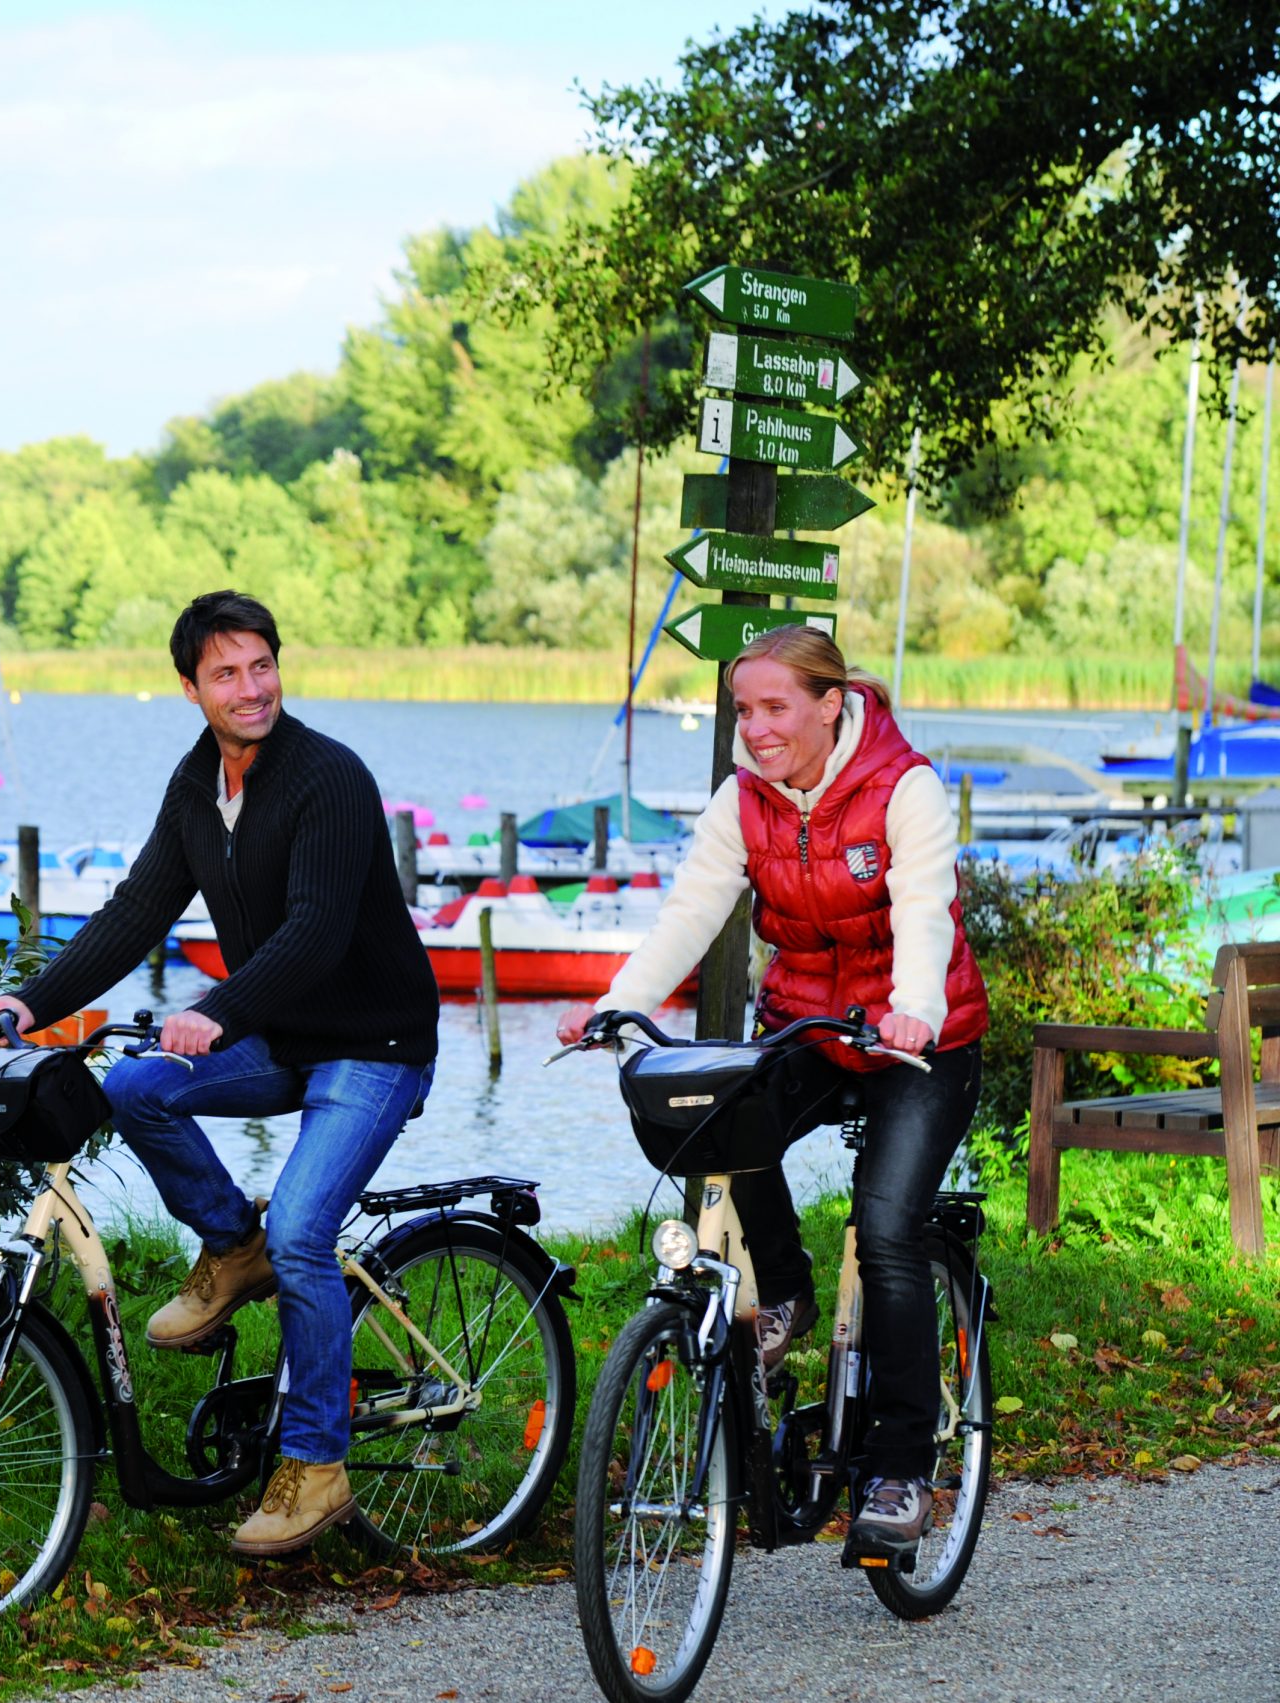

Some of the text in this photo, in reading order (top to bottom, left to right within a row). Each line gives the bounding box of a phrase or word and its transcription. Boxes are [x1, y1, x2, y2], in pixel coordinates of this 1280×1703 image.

[741, 272, 807, 307] Strangen
[776, 308, 790, 324] Km
[753, 344, 815, 377] Lassahn
[786, 376, 806, 398] km
[746, 409, 812, 442] Pahlhuus
[779, 444, 799, 463] km
[713, 548, 820, 583] Heimatmuseum
